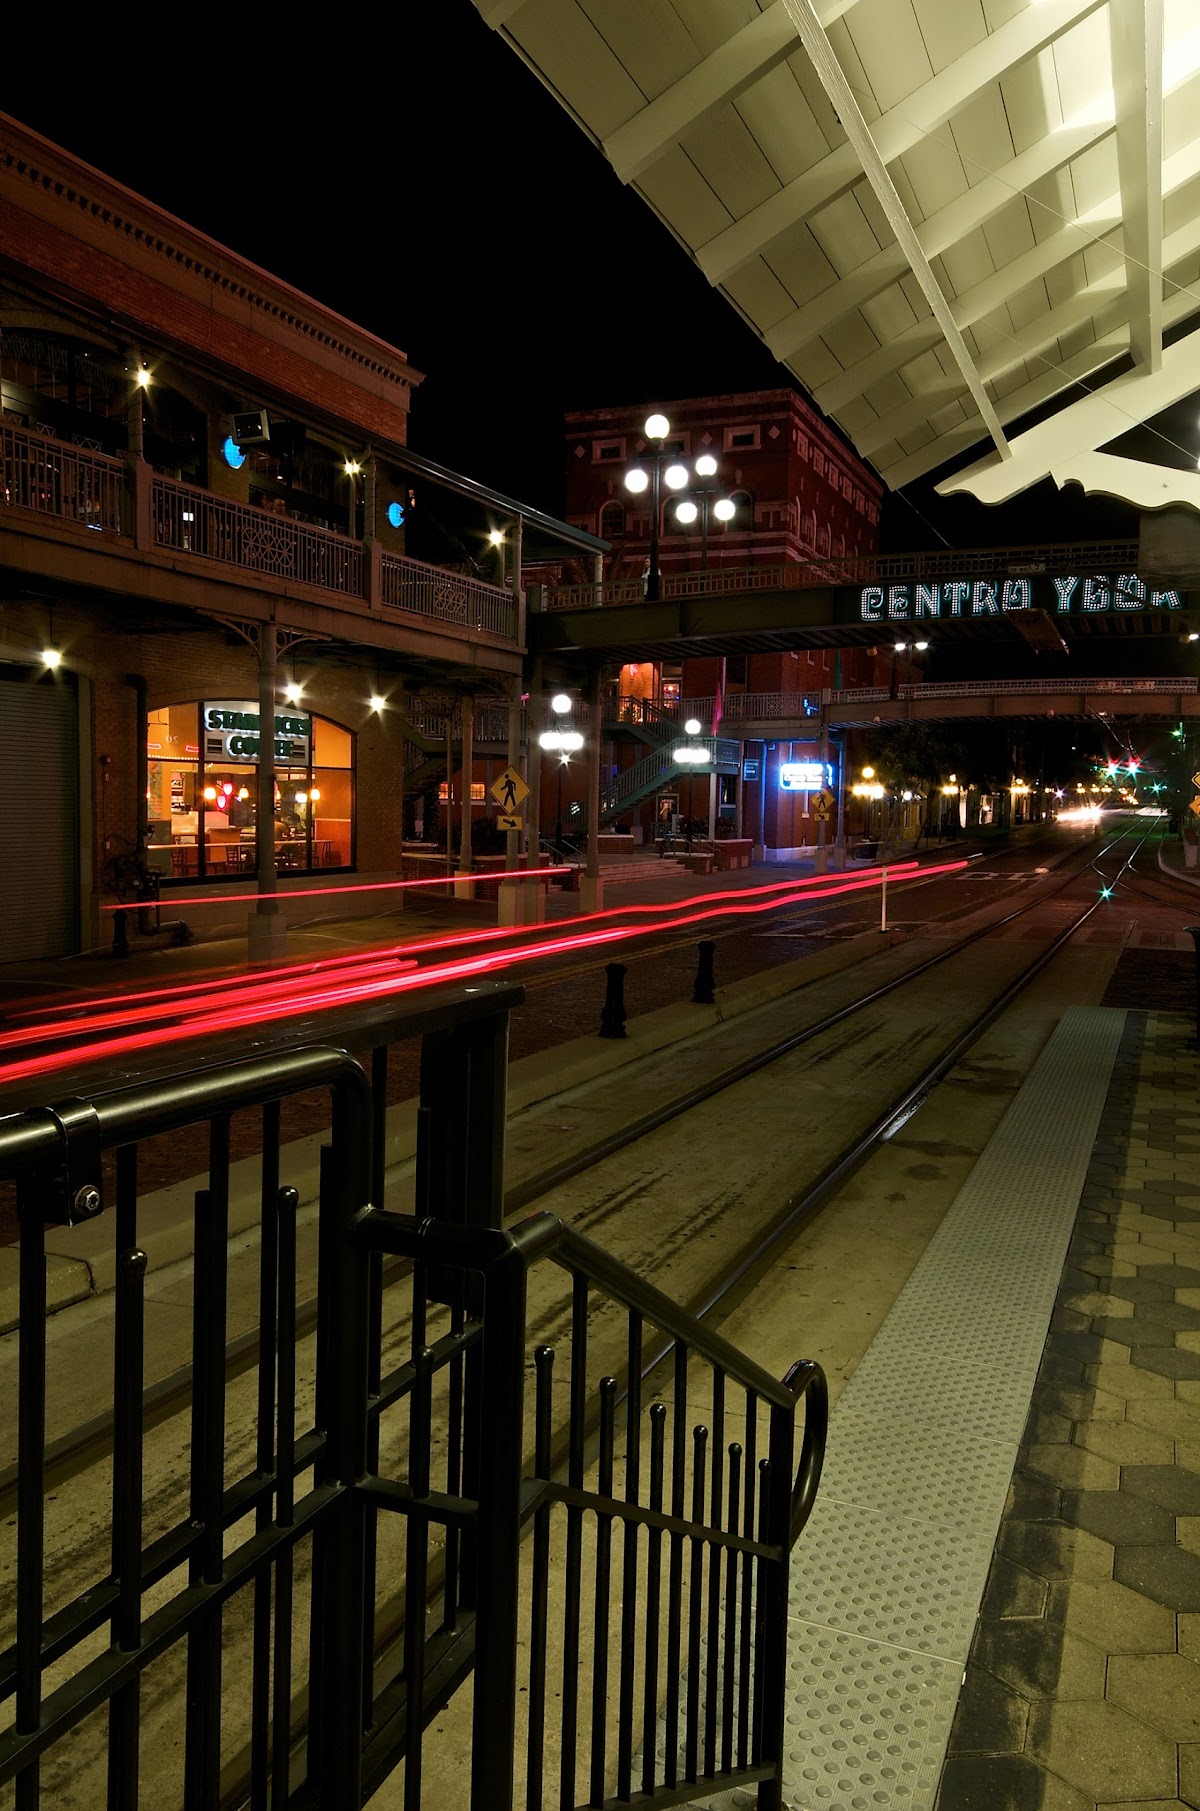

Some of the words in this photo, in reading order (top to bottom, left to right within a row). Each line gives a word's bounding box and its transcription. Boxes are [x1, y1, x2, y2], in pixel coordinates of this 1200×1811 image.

[861, 578, 1030, 620] CENTRO
[206, 709, 312, 737] STARCKS
[229, 736, 293, 756] COEE
